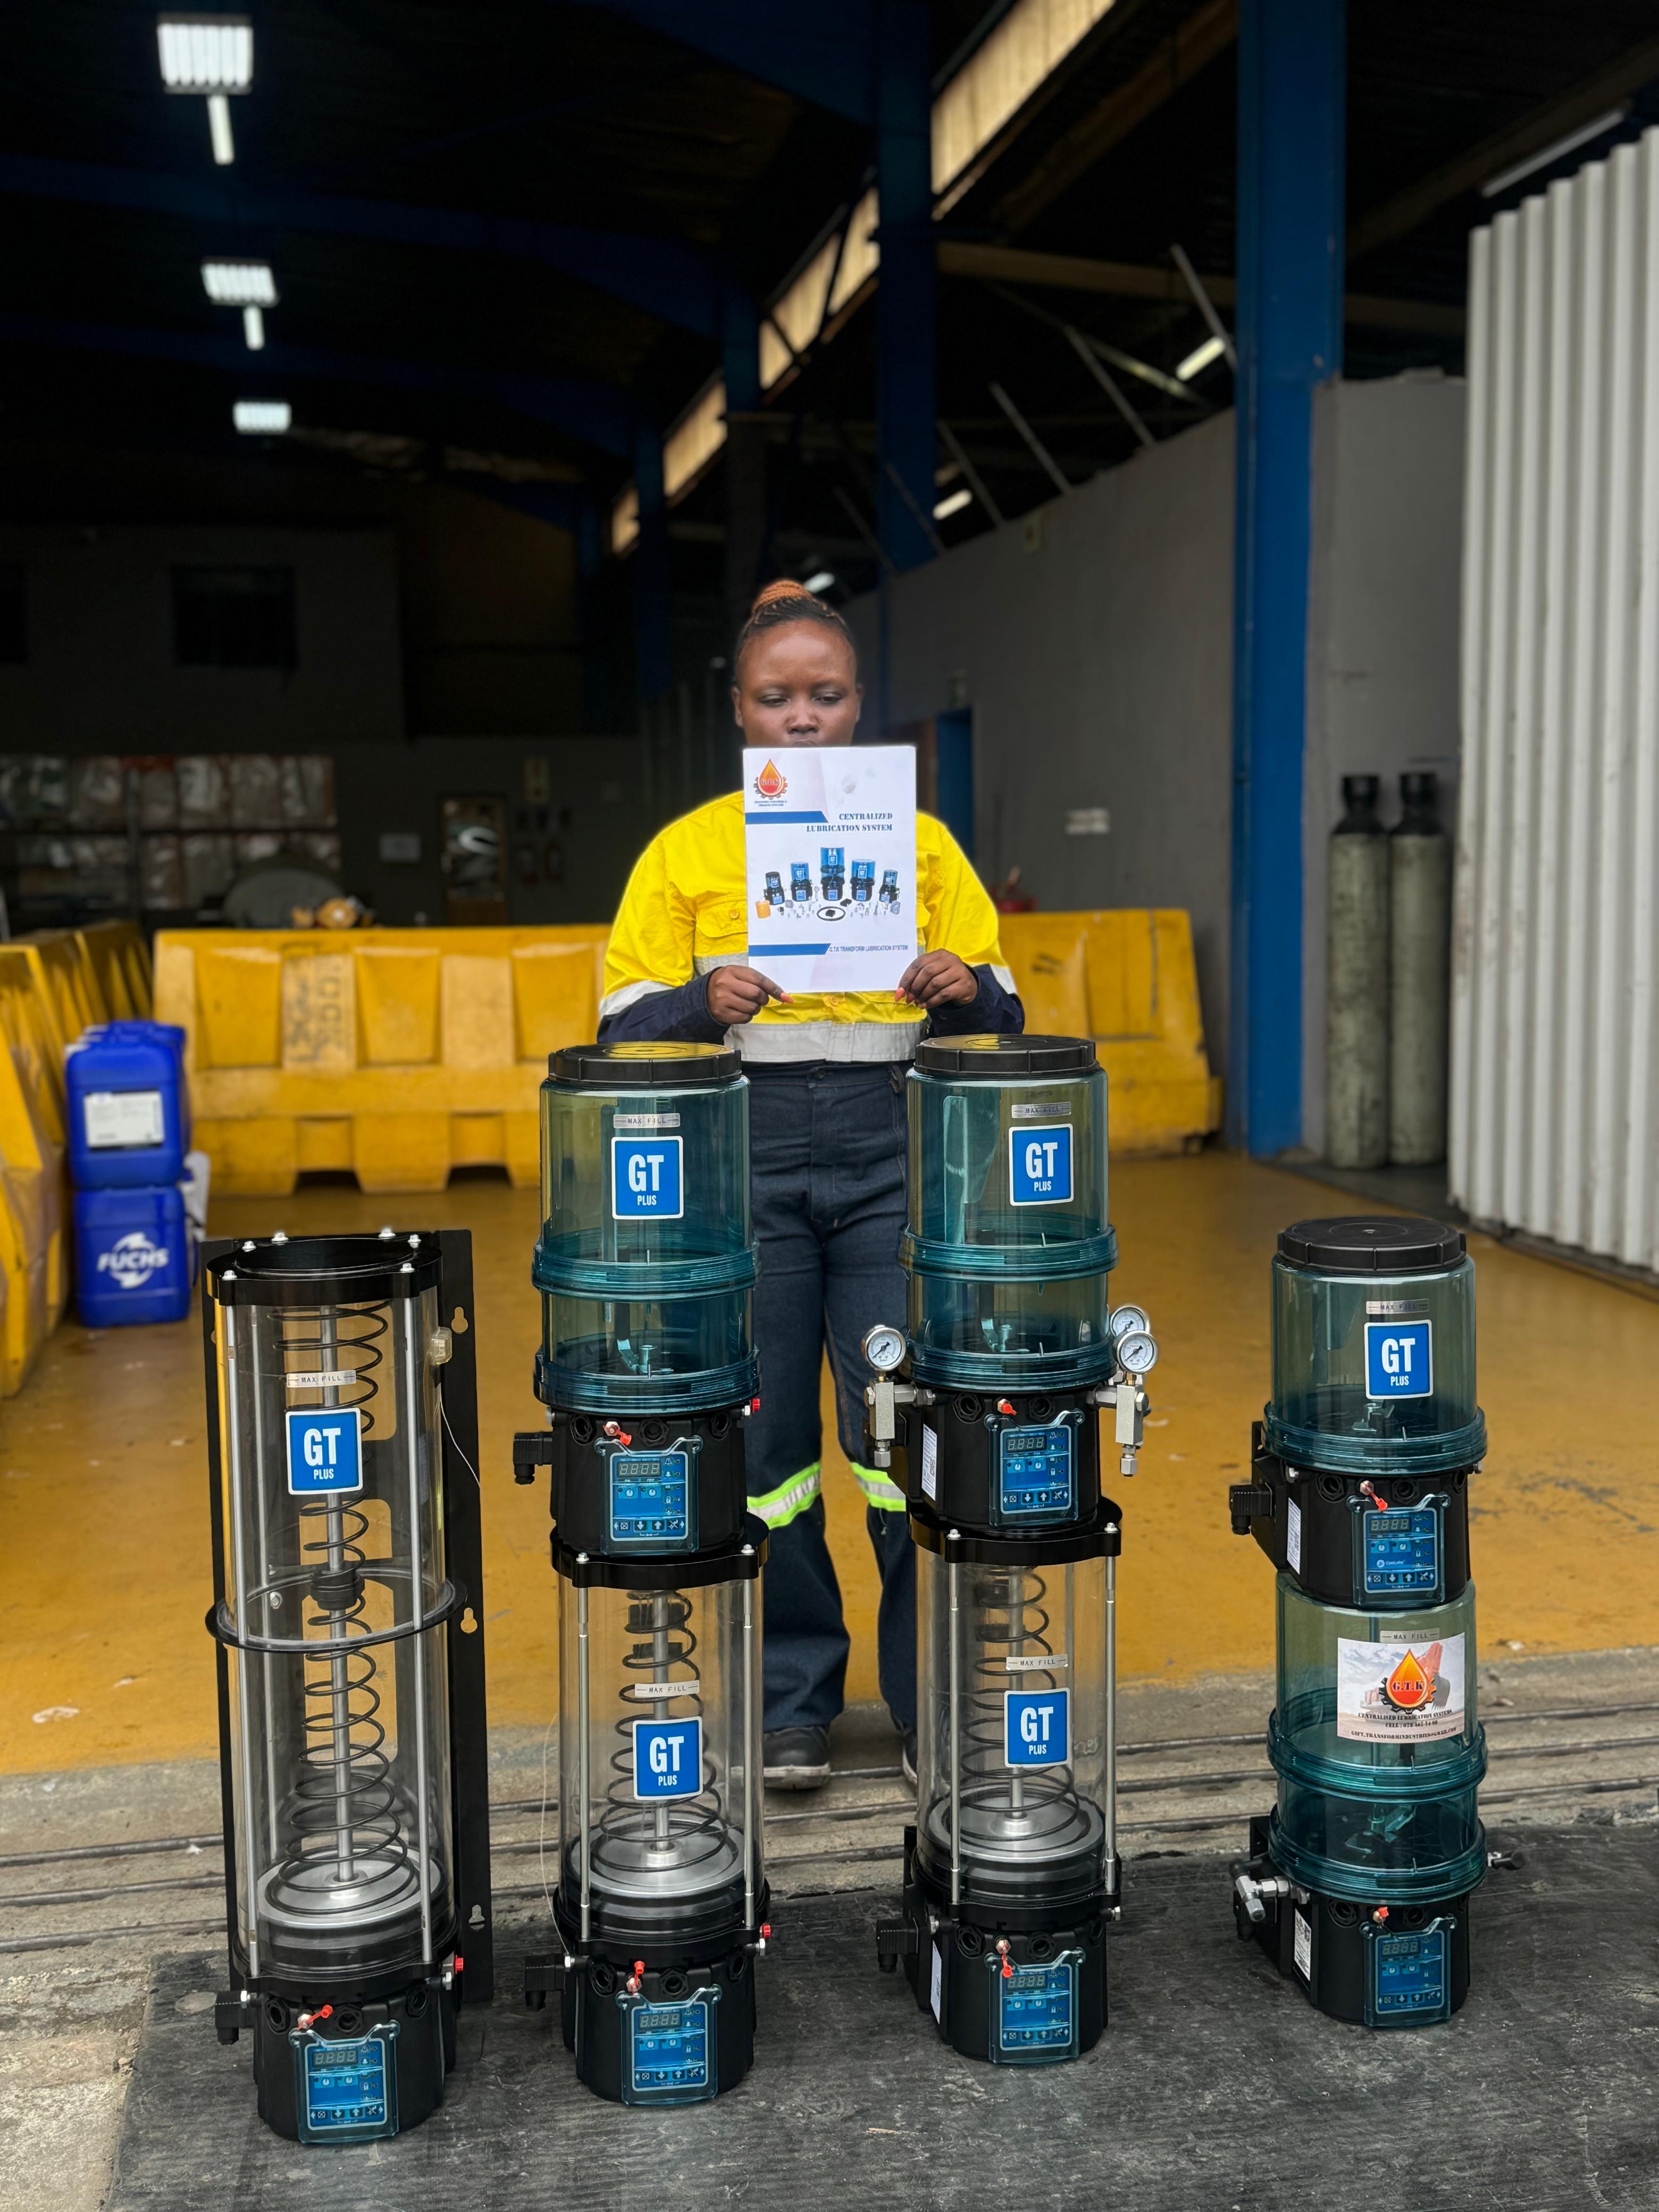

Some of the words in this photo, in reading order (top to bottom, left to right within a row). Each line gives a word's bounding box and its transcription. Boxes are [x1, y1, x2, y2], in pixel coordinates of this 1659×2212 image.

[1026, 1142, 1058, 1179] GT
[629, 1154, 664, 1192] GT
[1034, 1180, 1052, 1192] PLUS
[637, 1195, 657, 1206] PLUS
[97, 1247, 169, 1272] FUCHS
[1381, 1338, 1415, 1373] GT
[1390, 1375, 1409, 1386] PLUS
[304, 1428, 341, 1467] GT
[314, 1469, 334, 1480] PLUS
[1393, 1681, 1423, 1691] G.T.K
[1020, 1706, 1053, 1742] GT
[650, 1736, 684, 1773] GT
[1029, 1745, 1046, 1755] PLUS
[658, 1775, 677, 1786] PLUS
